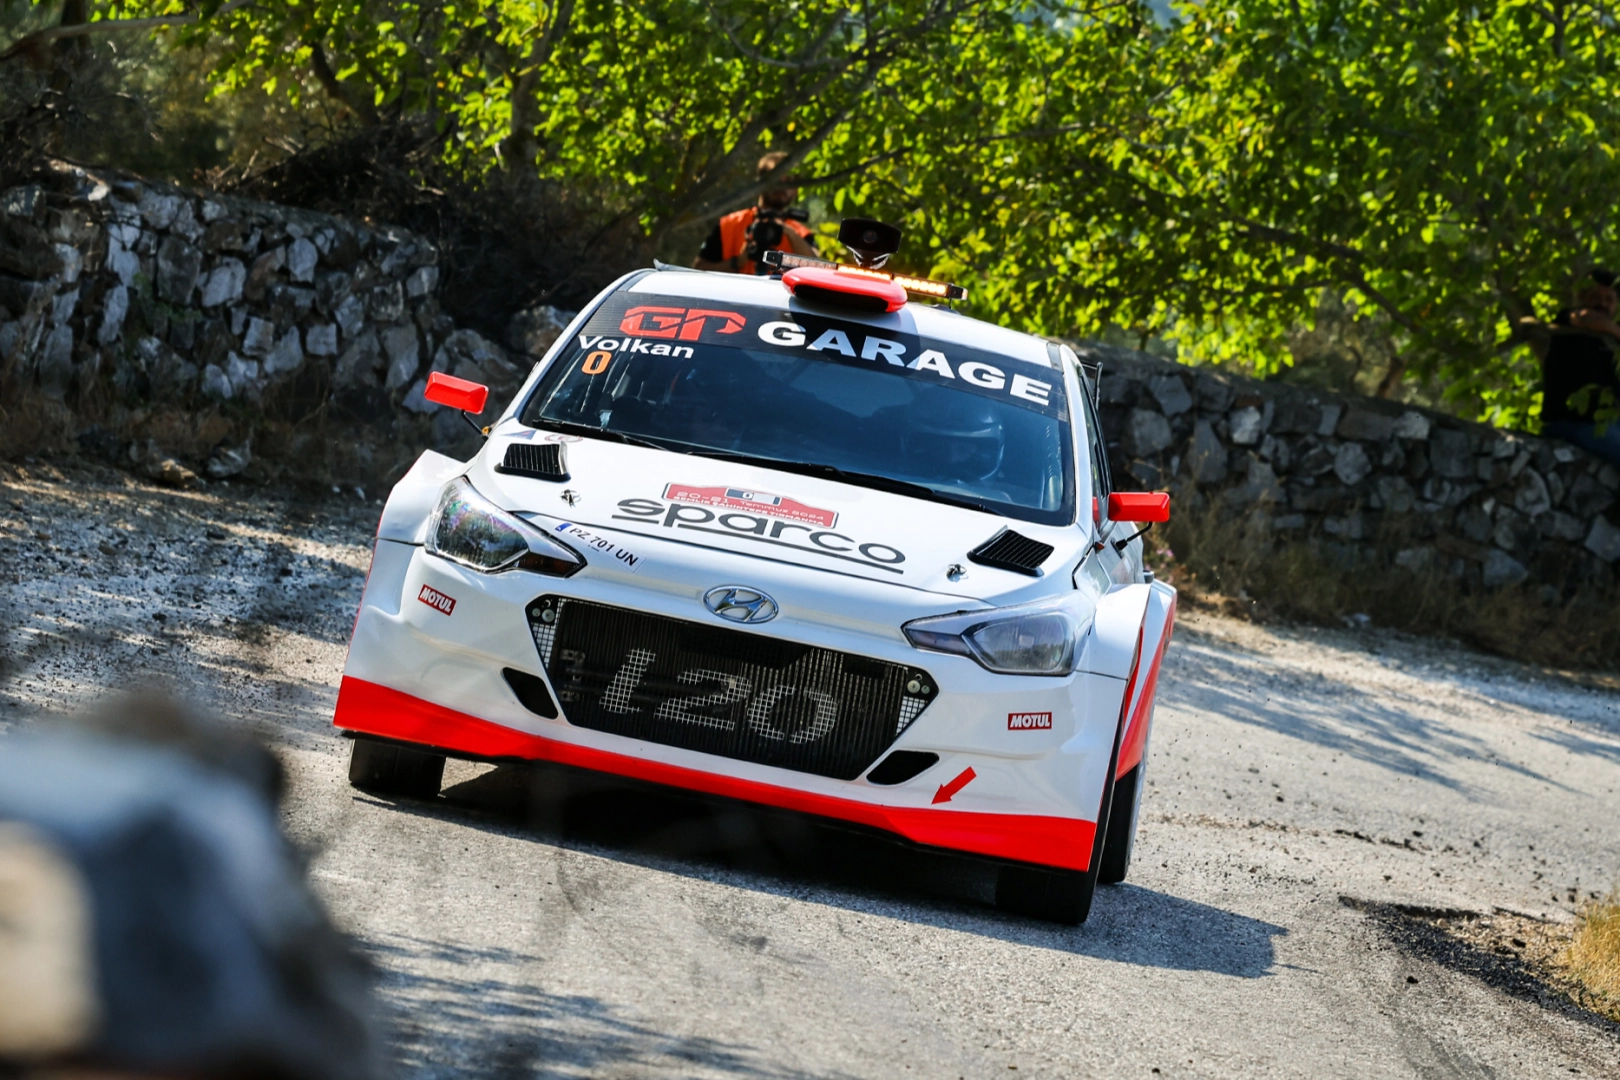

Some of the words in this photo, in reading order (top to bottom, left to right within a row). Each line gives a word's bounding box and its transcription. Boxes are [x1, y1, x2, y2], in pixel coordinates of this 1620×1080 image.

[578, 335, 694, 359] Volkan
[619, 305, 746, 341] GP
[757, 320, 1052, 406] GARAGE
[581, 350, 612, 375] 0
[616, 498, 906, 565] sparco
[569, 527, 591, 540] PZ
[590, 536, 616, 552] 701
[615, 548, 639, 567] UN
[419, 586, 453, 613] MOTUL
[1010, 713, 1051, 728] MOTUL
